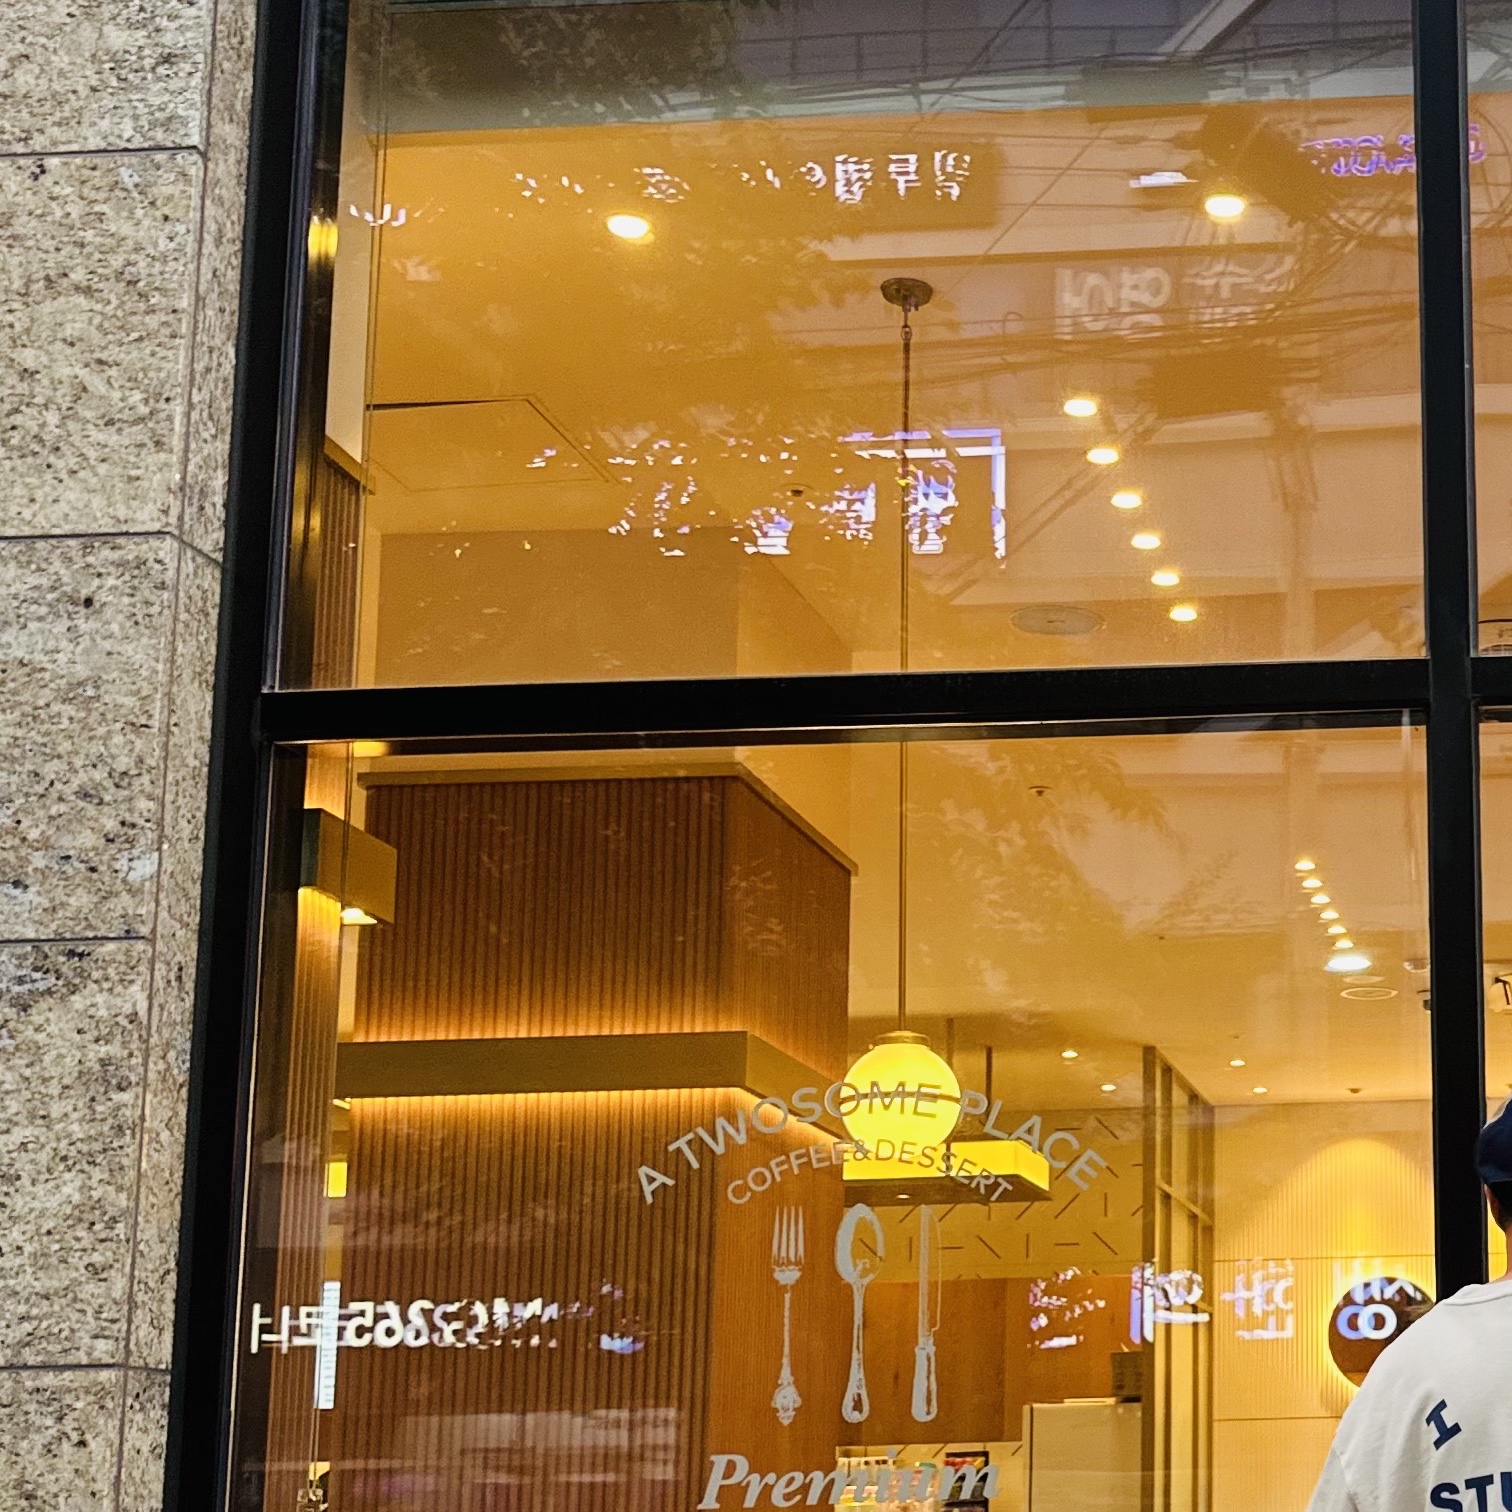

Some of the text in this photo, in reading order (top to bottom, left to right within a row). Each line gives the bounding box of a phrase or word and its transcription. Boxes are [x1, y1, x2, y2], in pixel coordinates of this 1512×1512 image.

[636, 1080, 1109, 1205] A TWOSOME PLACE
[727, 1138, 1013, 1205] COFFEE&DESSERT
[697, 1448, 1003, 1511] Premium
